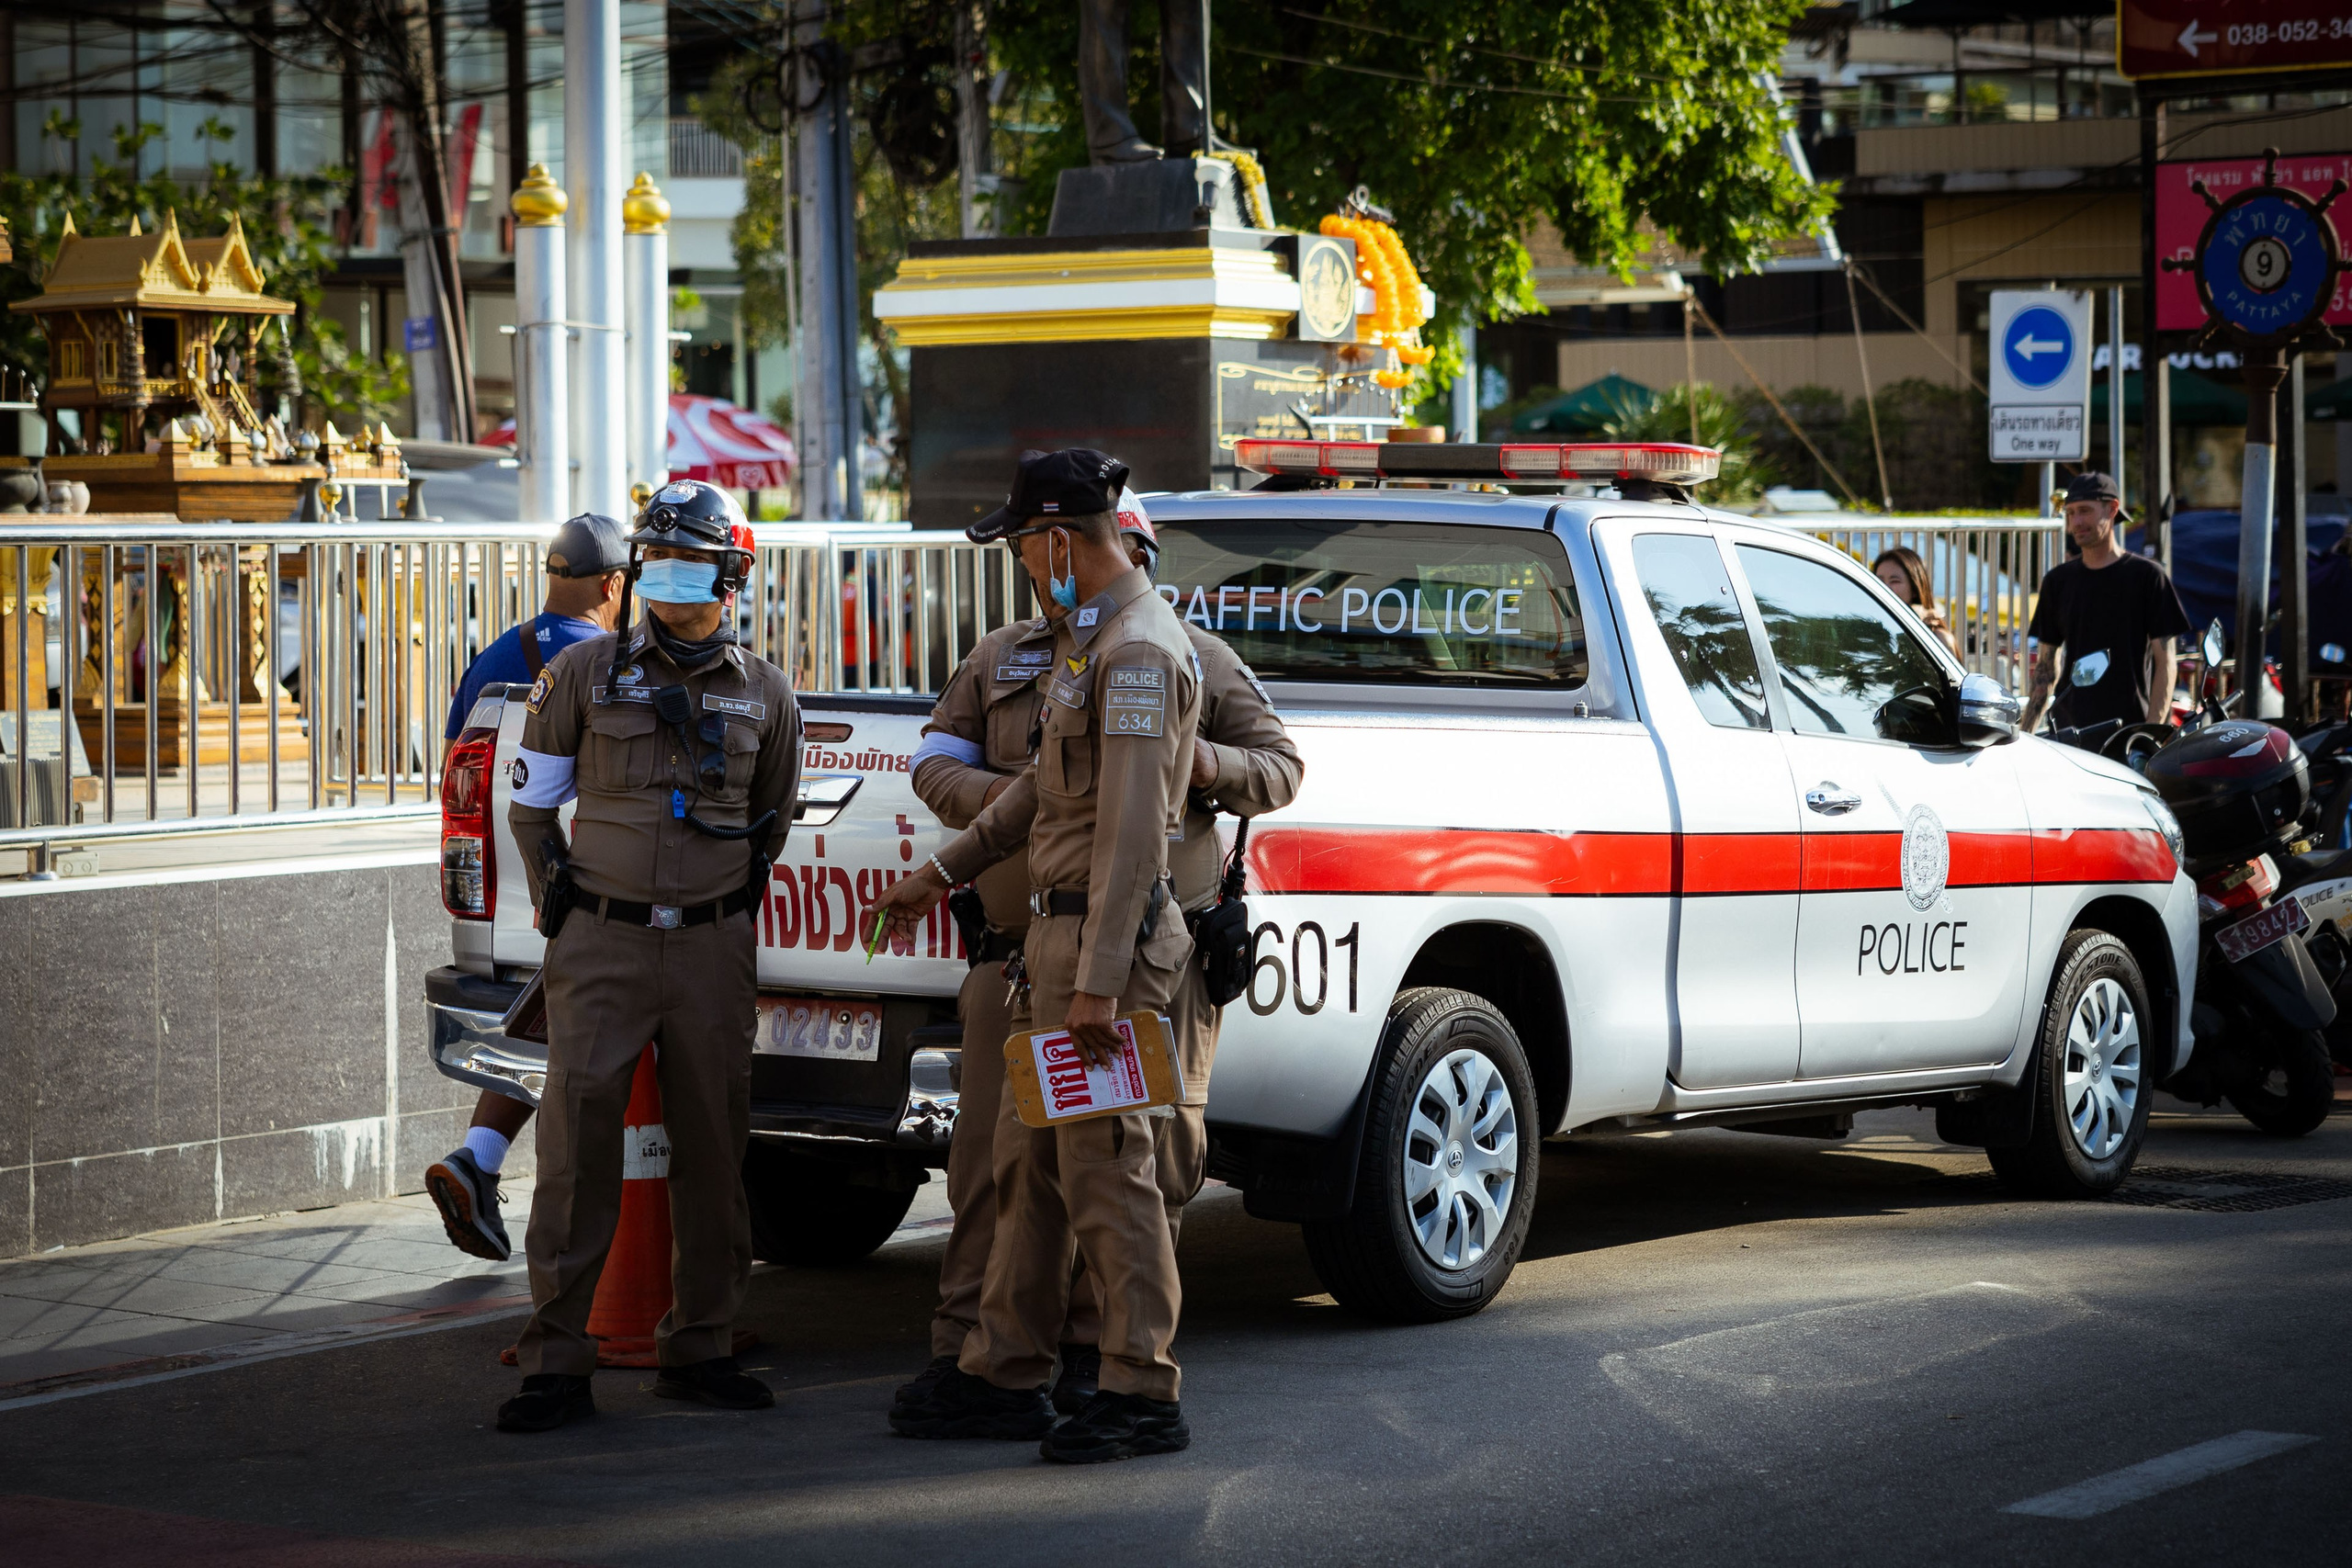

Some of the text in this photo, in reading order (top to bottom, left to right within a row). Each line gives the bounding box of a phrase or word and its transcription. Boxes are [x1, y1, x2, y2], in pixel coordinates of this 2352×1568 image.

[2251, 164, 2293, 184] พัยา
[2224, 209, 2306, 246] พัทยา
[2256, 252, 2273, 276] 9
[2227, 291, 2302, 319] PATTAYA
[2011, 434, 2061, 457] One way
[1154, 583, 1524, 635] RAFFIC POLICE
[1117, 673, 1159, 685] POLICE
[1118, 713, 1152, 731] 634
[804, 744, 911, 773] มืองพัทย
[2300, 886, 2334, 908] OLICE
[1858, 921, 1968, 976] POLICE
[770, 1006, 876, 1052] 02433
